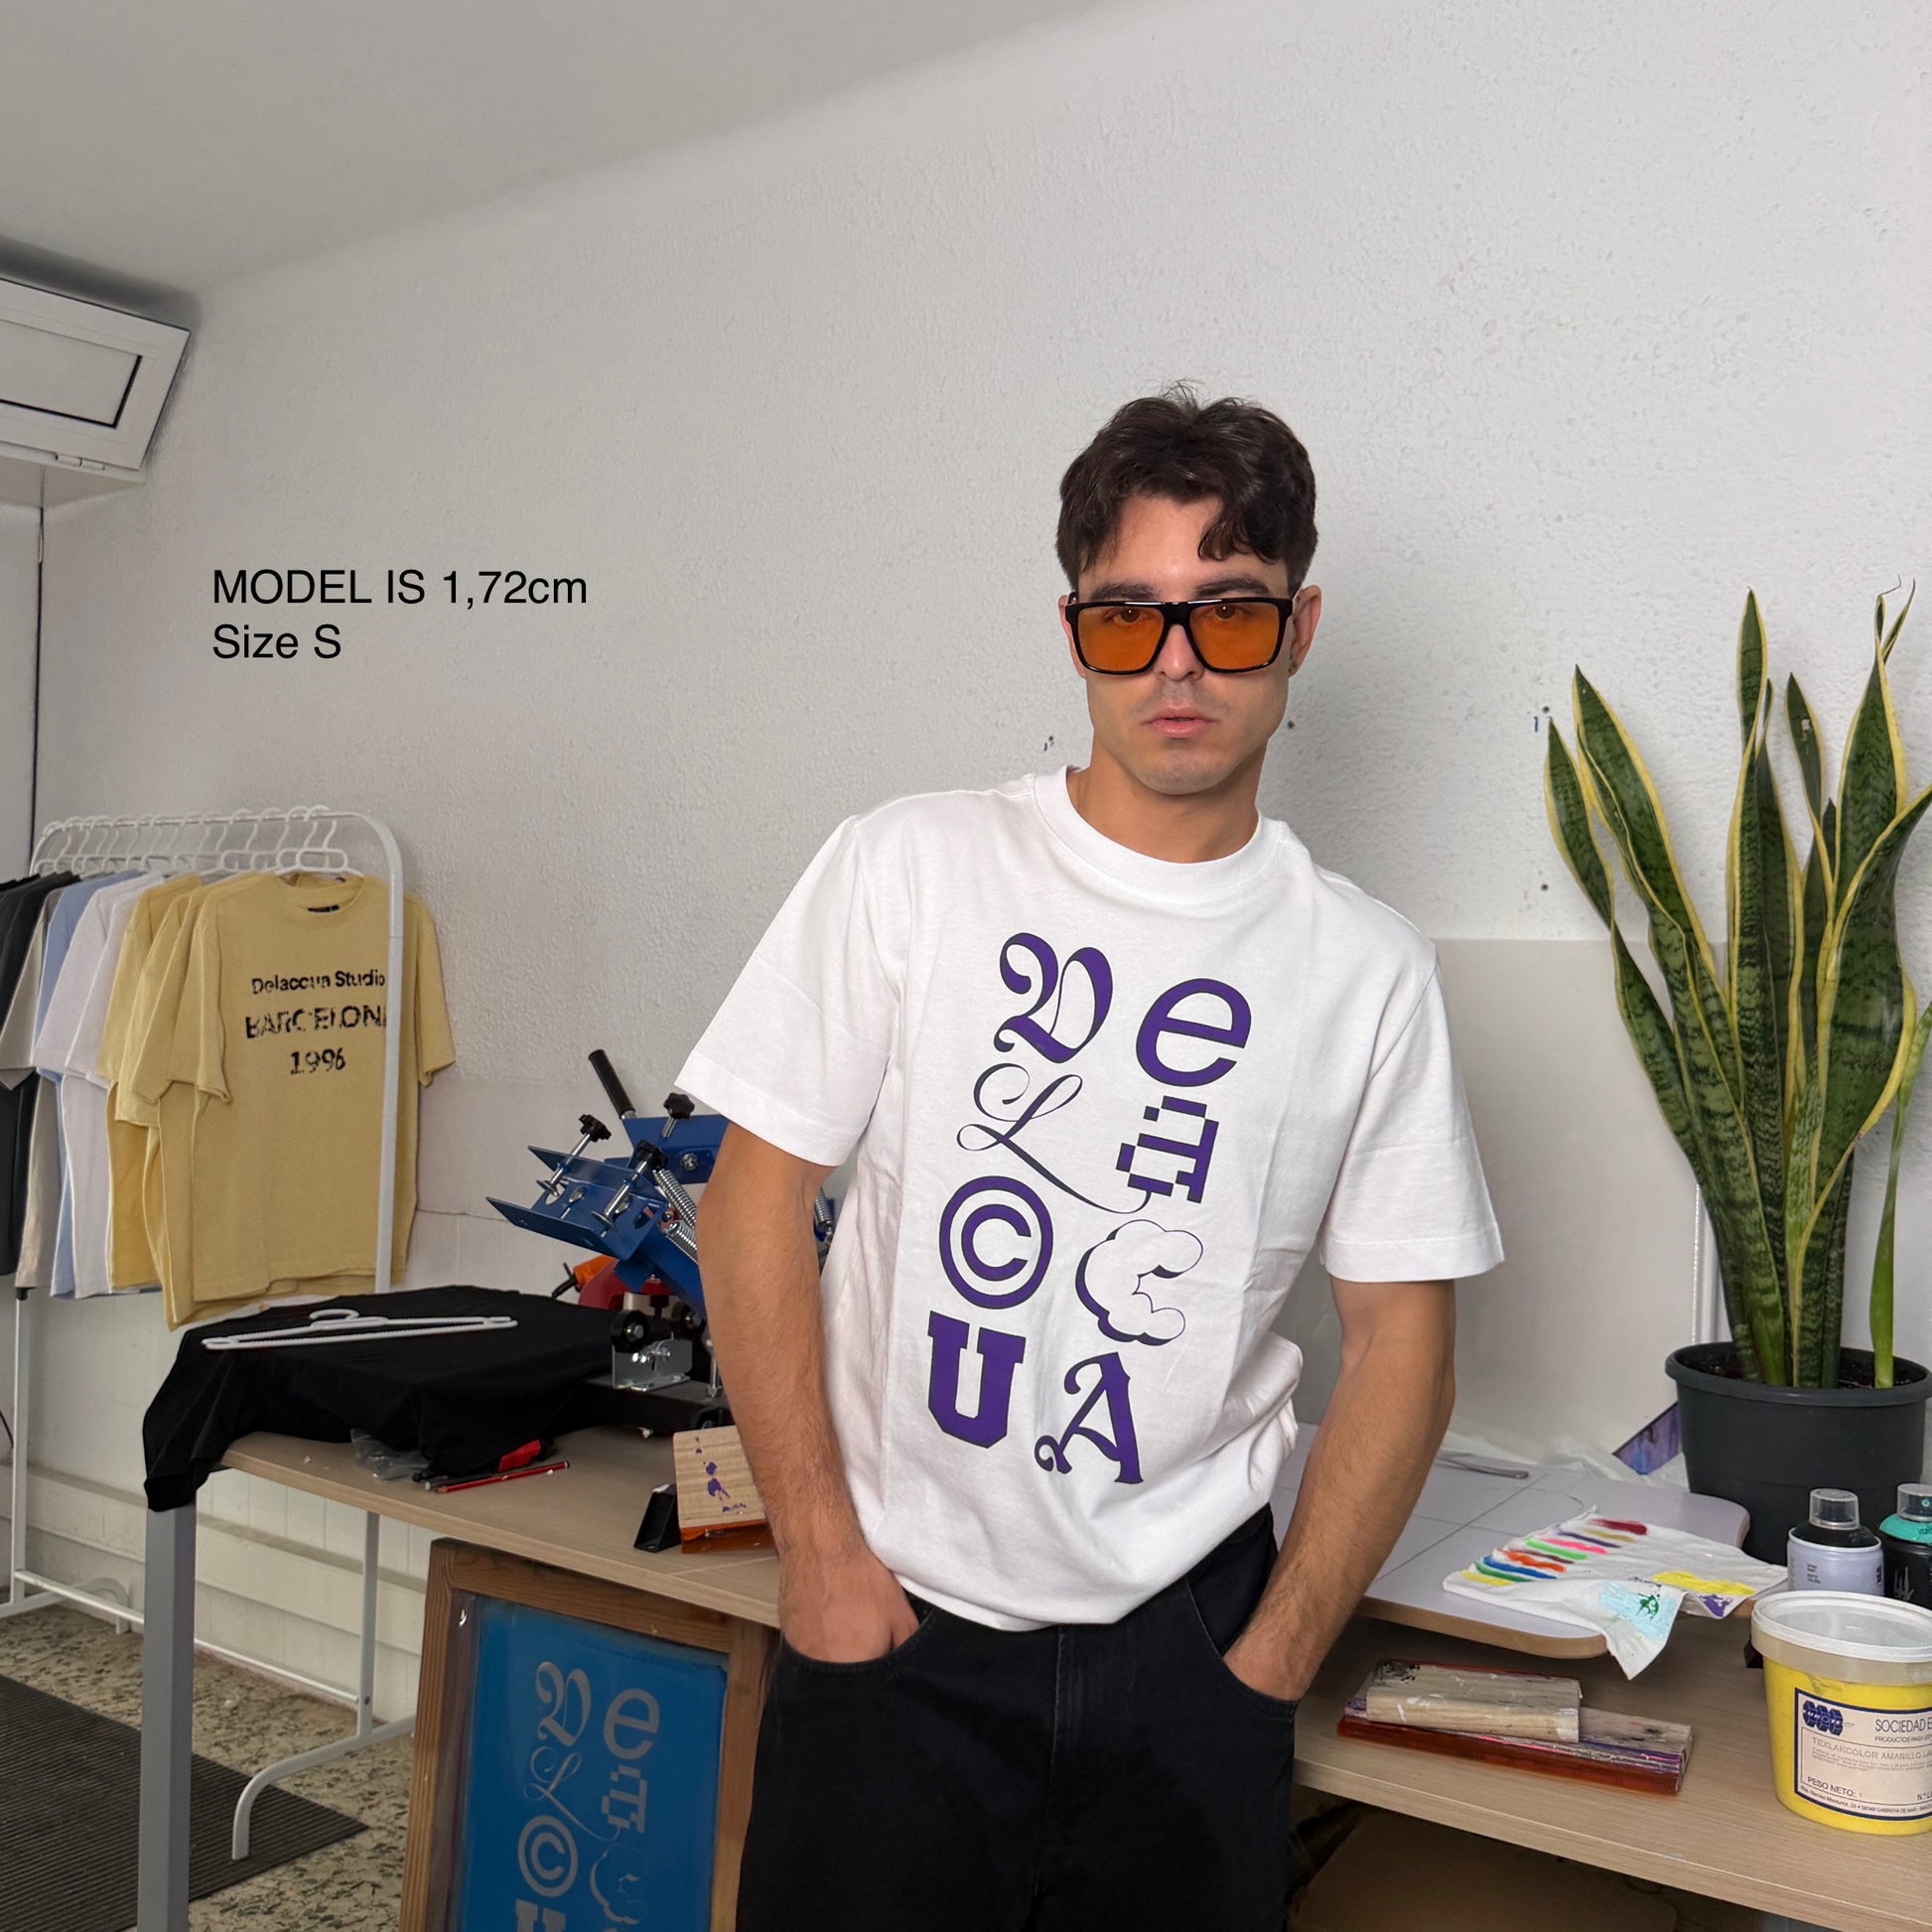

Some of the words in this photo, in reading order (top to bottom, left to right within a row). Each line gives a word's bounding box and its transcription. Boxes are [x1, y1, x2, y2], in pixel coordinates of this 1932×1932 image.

[335, 969, 386, 988] Studio
[245, 1005, 386, 1039] BARCELON
[289, 1047, 346, 1075] 1996
[1874, 1718, 1925, 1733] SOCIEDAD
[1812, 1737, 1878, 1760] TEXLAKCOLOR
[1880, 1751, 1922, 1760] AMARILLO
[1807, 1776, 1829, 1791] PESO
[1830, 1784, 1857, 1798] NETO:
